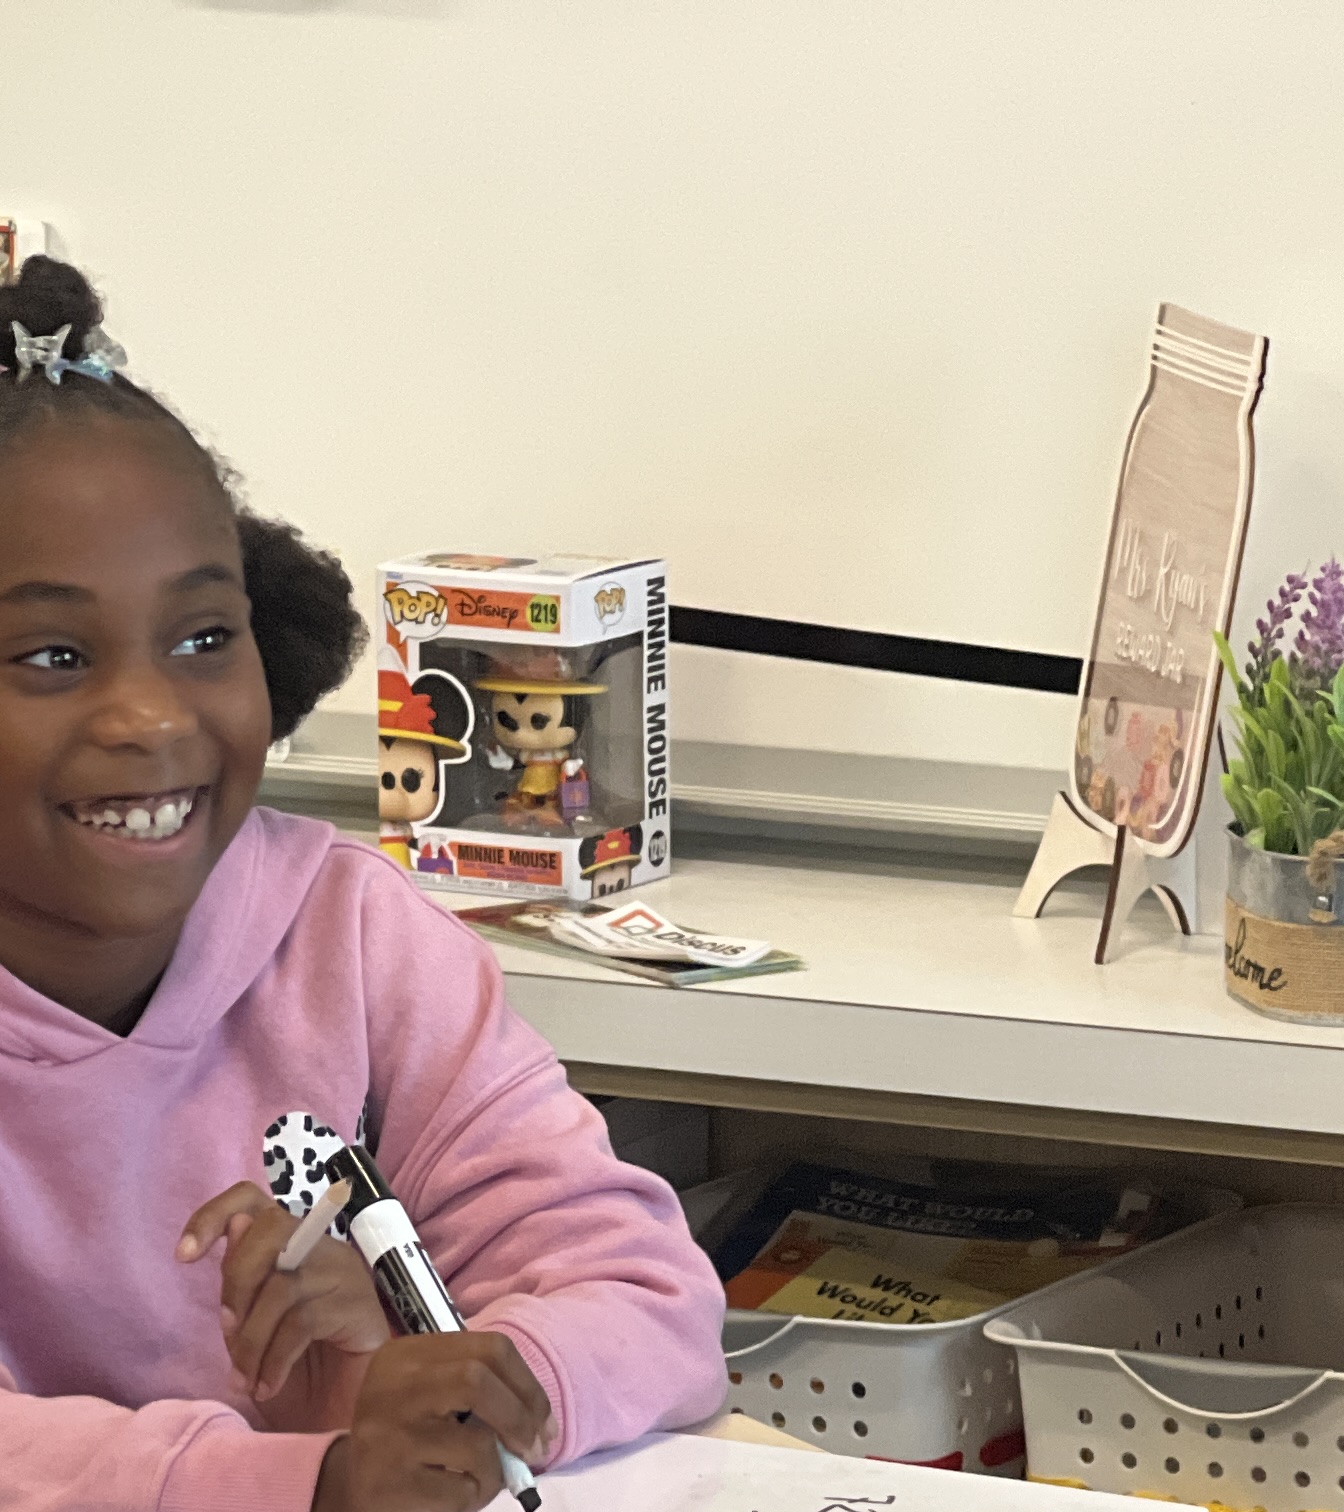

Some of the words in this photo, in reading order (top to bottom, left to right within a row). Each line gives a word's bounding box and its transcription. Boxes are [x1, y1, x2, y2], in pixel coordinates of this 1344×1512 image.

[383, 587, 448, 626] POP!
[528, 601, 559, 626] 1219
[593, 586, 627, 620] POP!
[644, 575, 667, 695] MINNIE
[645, 702, 668, 820] MOUSE
[456, 845, 506, 865] MINNIE
[508, 850, 558, 871] MOUSE
[654, 930, 748, 958] DISCUS
[816, 1281, 906, 1319] Would
[870, 1273, 944, 1308] What
